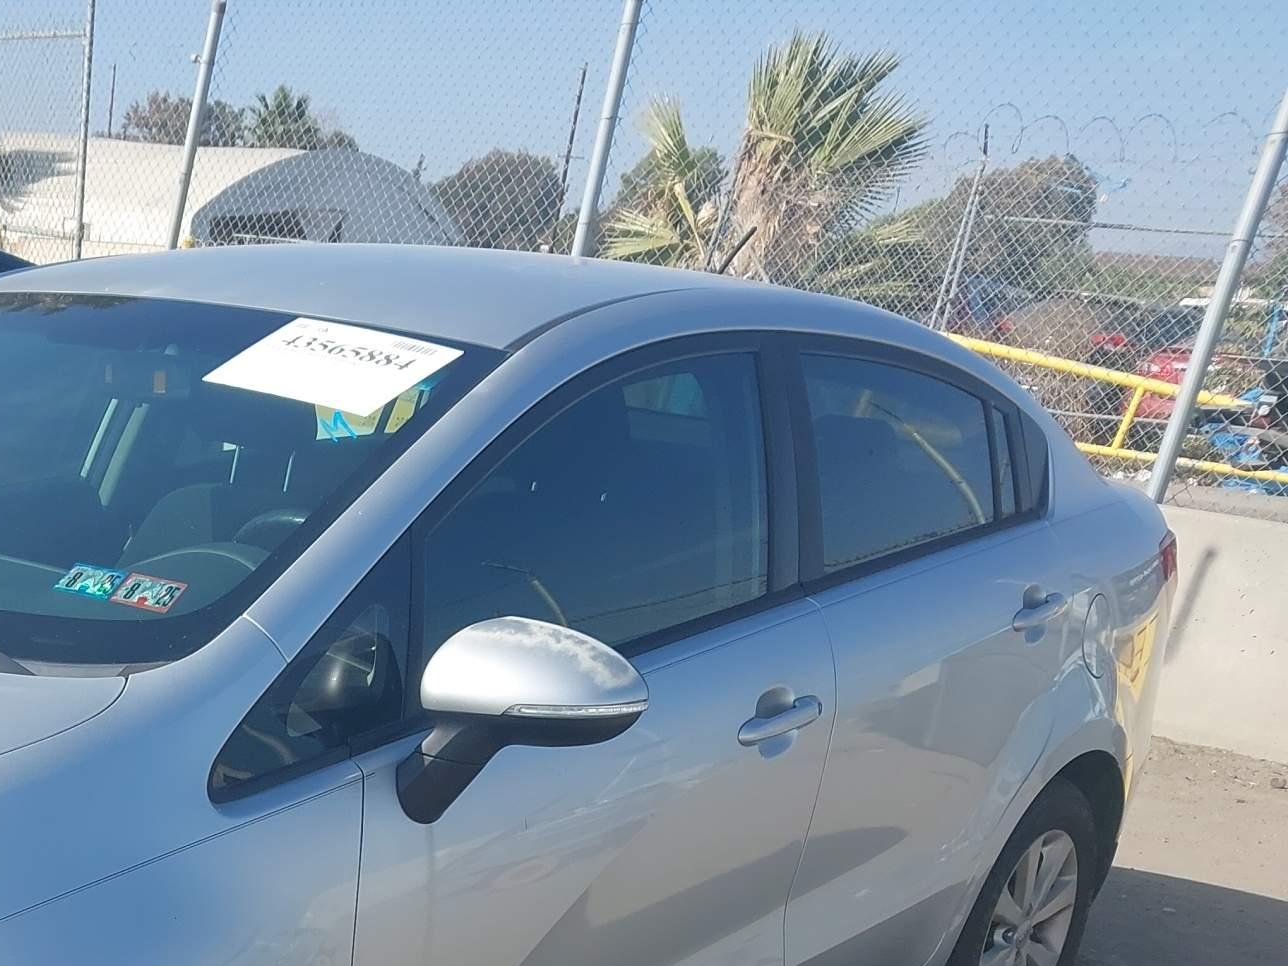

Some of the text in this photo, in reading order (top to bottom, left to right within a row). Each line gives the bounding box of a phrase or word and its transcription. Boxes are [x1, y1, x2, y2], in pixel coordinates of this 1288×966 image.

[282, 334, 417, 371] 43565884
[65, 571, 83, 588] 8
[123, 582, 181, 607] 8 25
